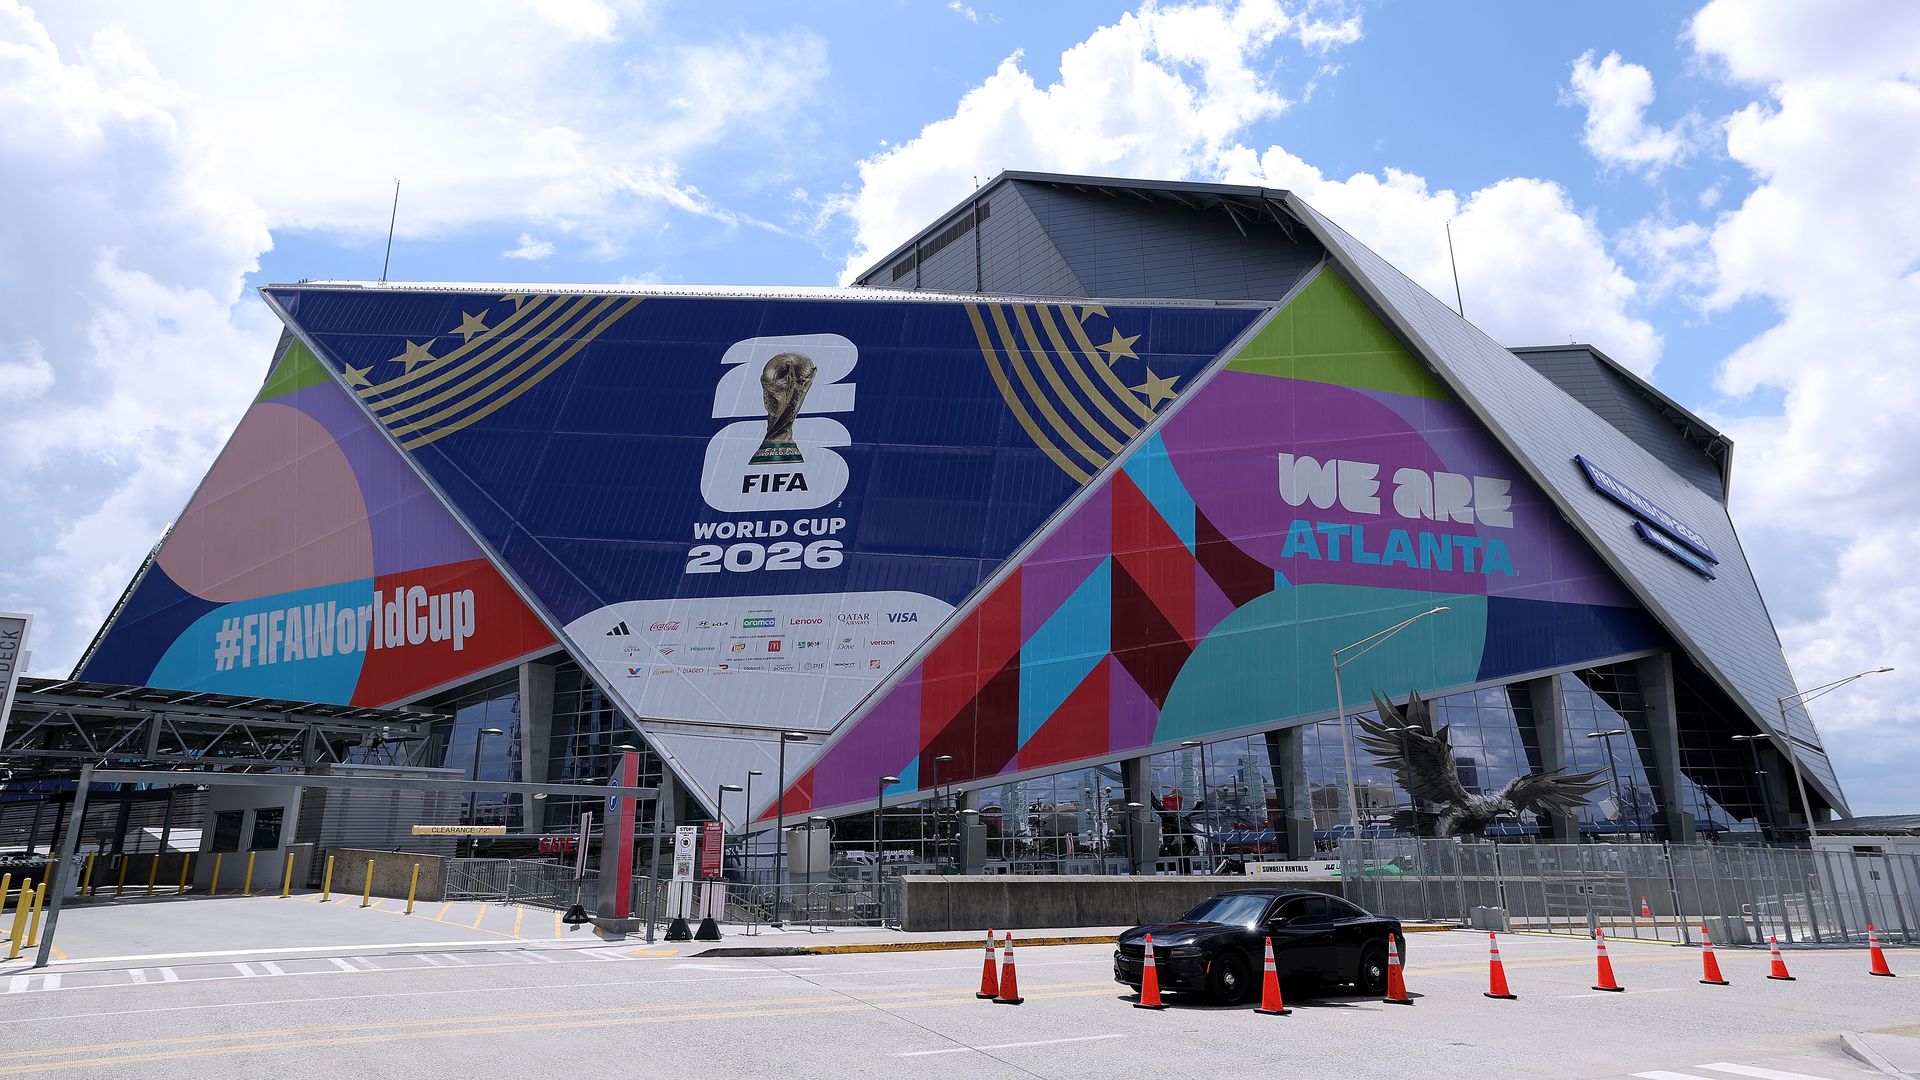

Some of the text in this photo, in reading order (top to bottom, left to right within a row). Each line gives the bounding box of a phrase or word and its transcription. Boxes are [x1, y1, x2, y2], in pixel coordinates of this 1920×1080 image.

[741, 473, 808, 494] FIFA
[1278, 452, 1381, 515] WE
[693, 517, 846, 540] WORLD CUP
[686, 540, 844, 574] 2026
[1280, 520, 1514, 577] ATLANTA
[214, 585, 476, 672] #FIFAWorldCup
[837, 612, 870, 622] QATAR
[886, 612, 918, 623] VISA
[539, 838, 575, 853] GATE
